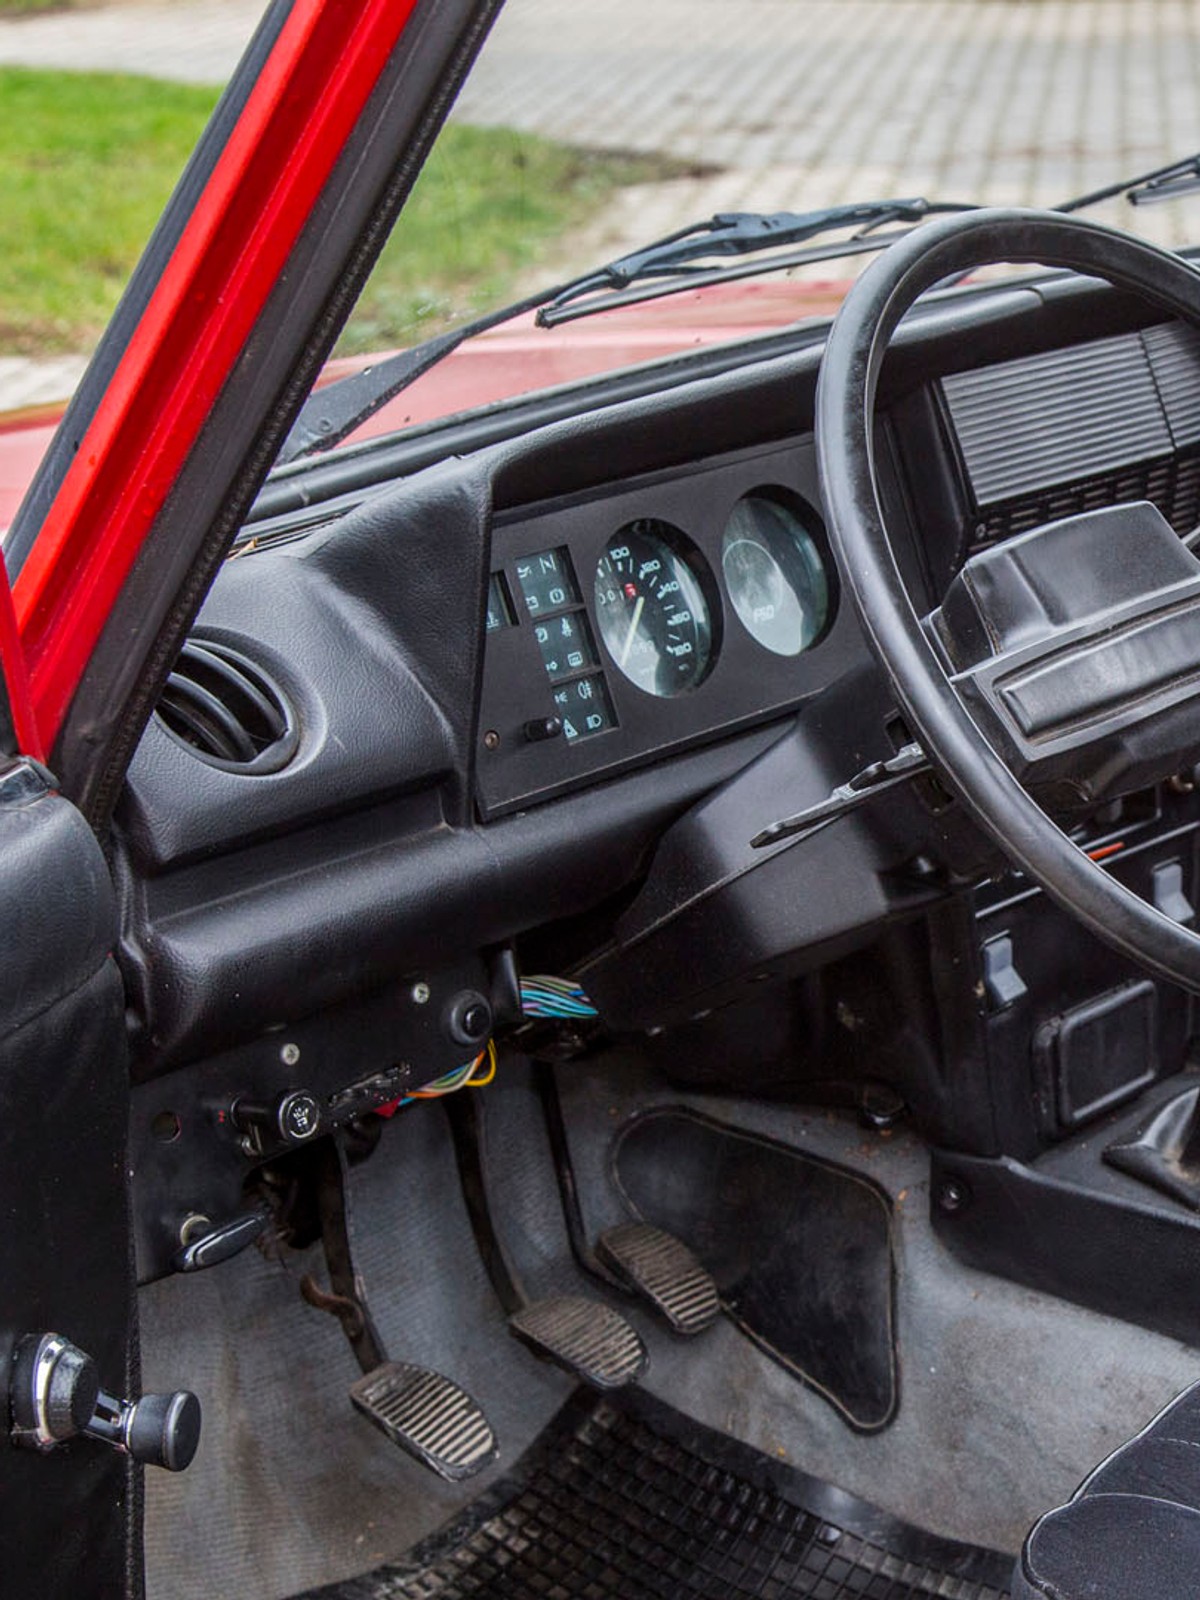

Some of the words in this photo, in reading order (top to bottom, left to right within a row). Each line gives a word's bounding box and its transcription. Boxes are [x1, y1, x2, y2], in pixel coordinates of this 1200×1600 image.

[610, 547, 630, 560] 100
[641, 559, 661, 573] 120
[660, 581, 680, 595] 140
